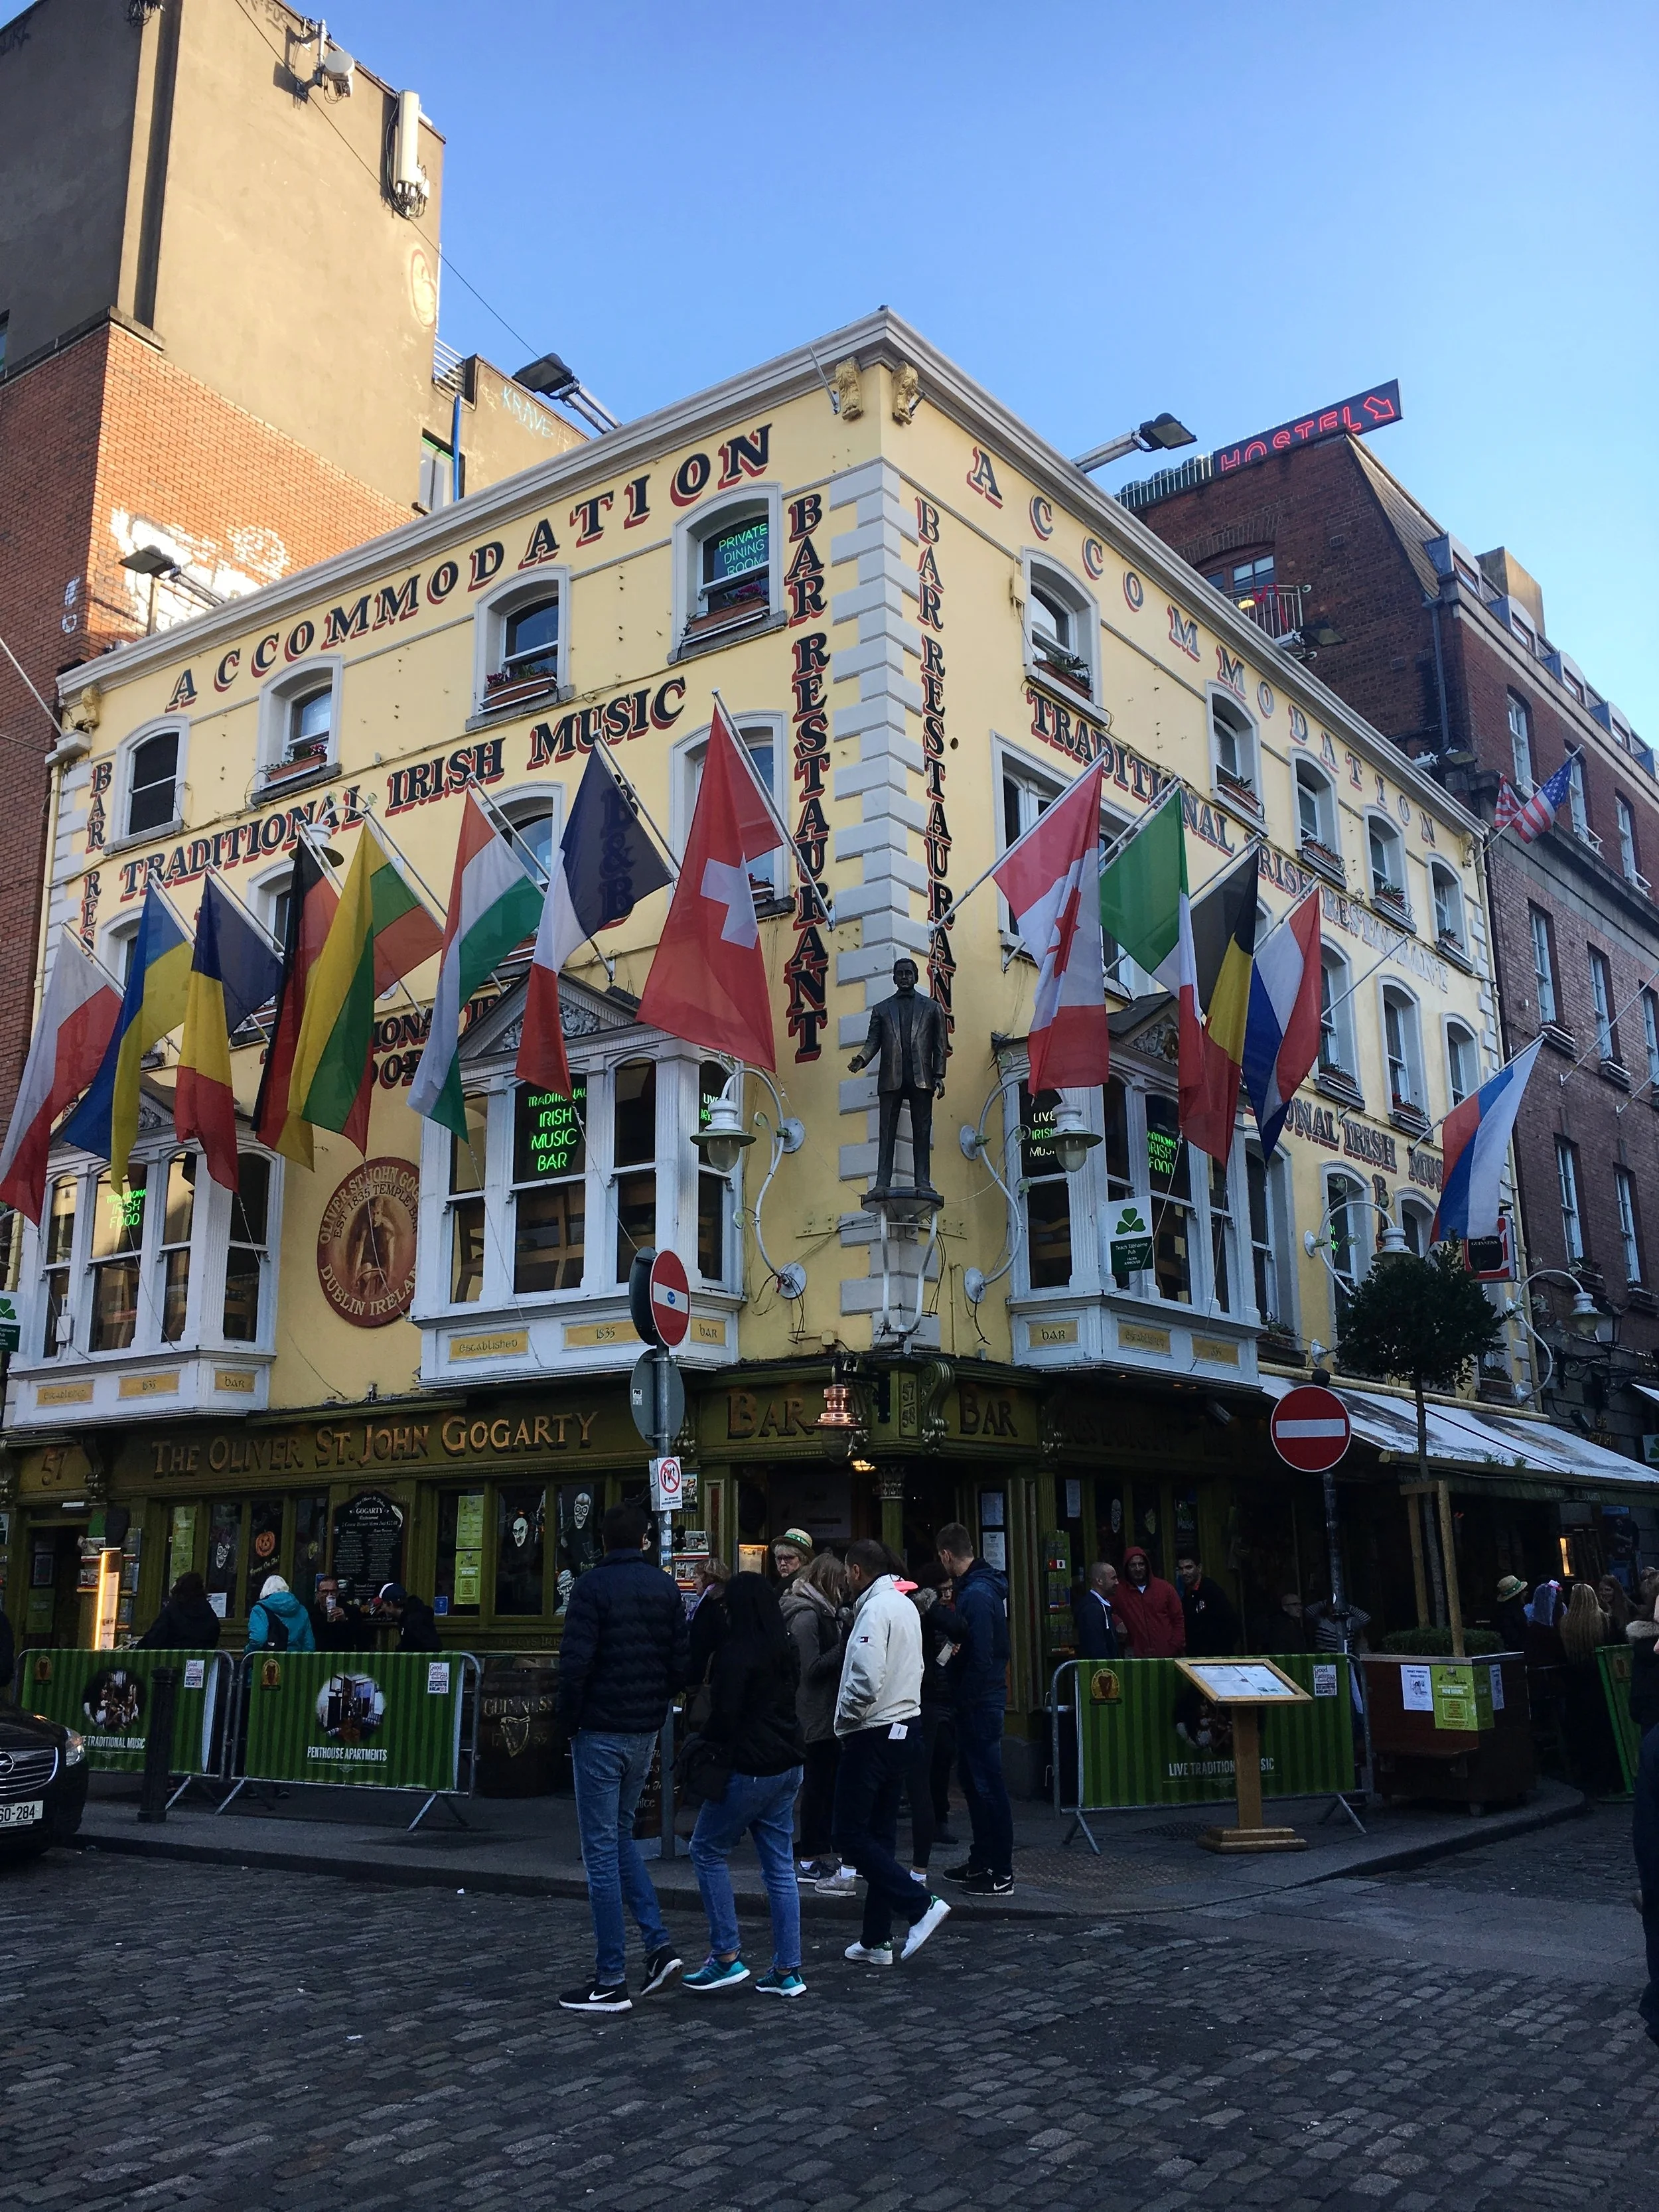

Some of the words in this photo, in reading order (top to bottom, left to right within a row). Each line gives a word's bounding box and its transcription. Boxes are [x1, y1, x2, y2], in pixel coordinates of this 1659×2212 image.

[719, 523, 768, 552] PRIVATE
[724, 539, 764, 564] DINING
[784, 492, 829, 628] BAR
[165, 422, 772, 713] ACCOMMODATION
[727, 554, 764, 575] ROOM
[915, 495, 944, 633] BAR
[966, 445, 1436, 848] ACCOMMODATION
[85, 761, 113, 854] BAR
[119, 784, 364, 901] TRADITIONAL
[385, 737, 506, 816] IRISH
[527, 676, 686, 770] MUSIC
[783, 631, 831, 1064] RESTAURANT
[531, 1128, 577, 1150] MUSIC
[540, 1107, 572, 1127] IRISH
[1033, 1110, 1056, 1123] LIVE
[538, 1152, 567, 1171] BAR
[1342, 1118, 1397, 1174] IRISH
[109, 1213, 140, 1229] FOOD
[319, 1188, 352, 1245] OLIVER
[366, 1165, 399, 1183] JOHN
[334, 1211, 348, 1239] EST
[348, 1186, 371, 1212] 1835
[373, 1183, 410, 1207] TEMPLE
[320, 1264, 366, 1316] DUBLIN
[597, 1327, 616, 1339] 1835
[727, 1389, 815, 1440] BAR
[959, 1386, 1019, 1438] BAR
[152, 1439, 199, 1479] THE
[209, 1435, 304, 1473] OLIVER
[358, 1424, 430, 1468] JOHN
[441, 1410, 599, 1457] GOGARTY
[88, 1735, 126, 1748] TRADITIONAL
[127, 1737, 145, 1749] MUSIC
[307, 1745, 344, 1759] PENTHOUSE
[344, 1747, 388, 1761] APARTMENTS
[1168, 1762, 1189, 1777] LIVE
[1190, 1759, 1236, 1775] TRADITION
